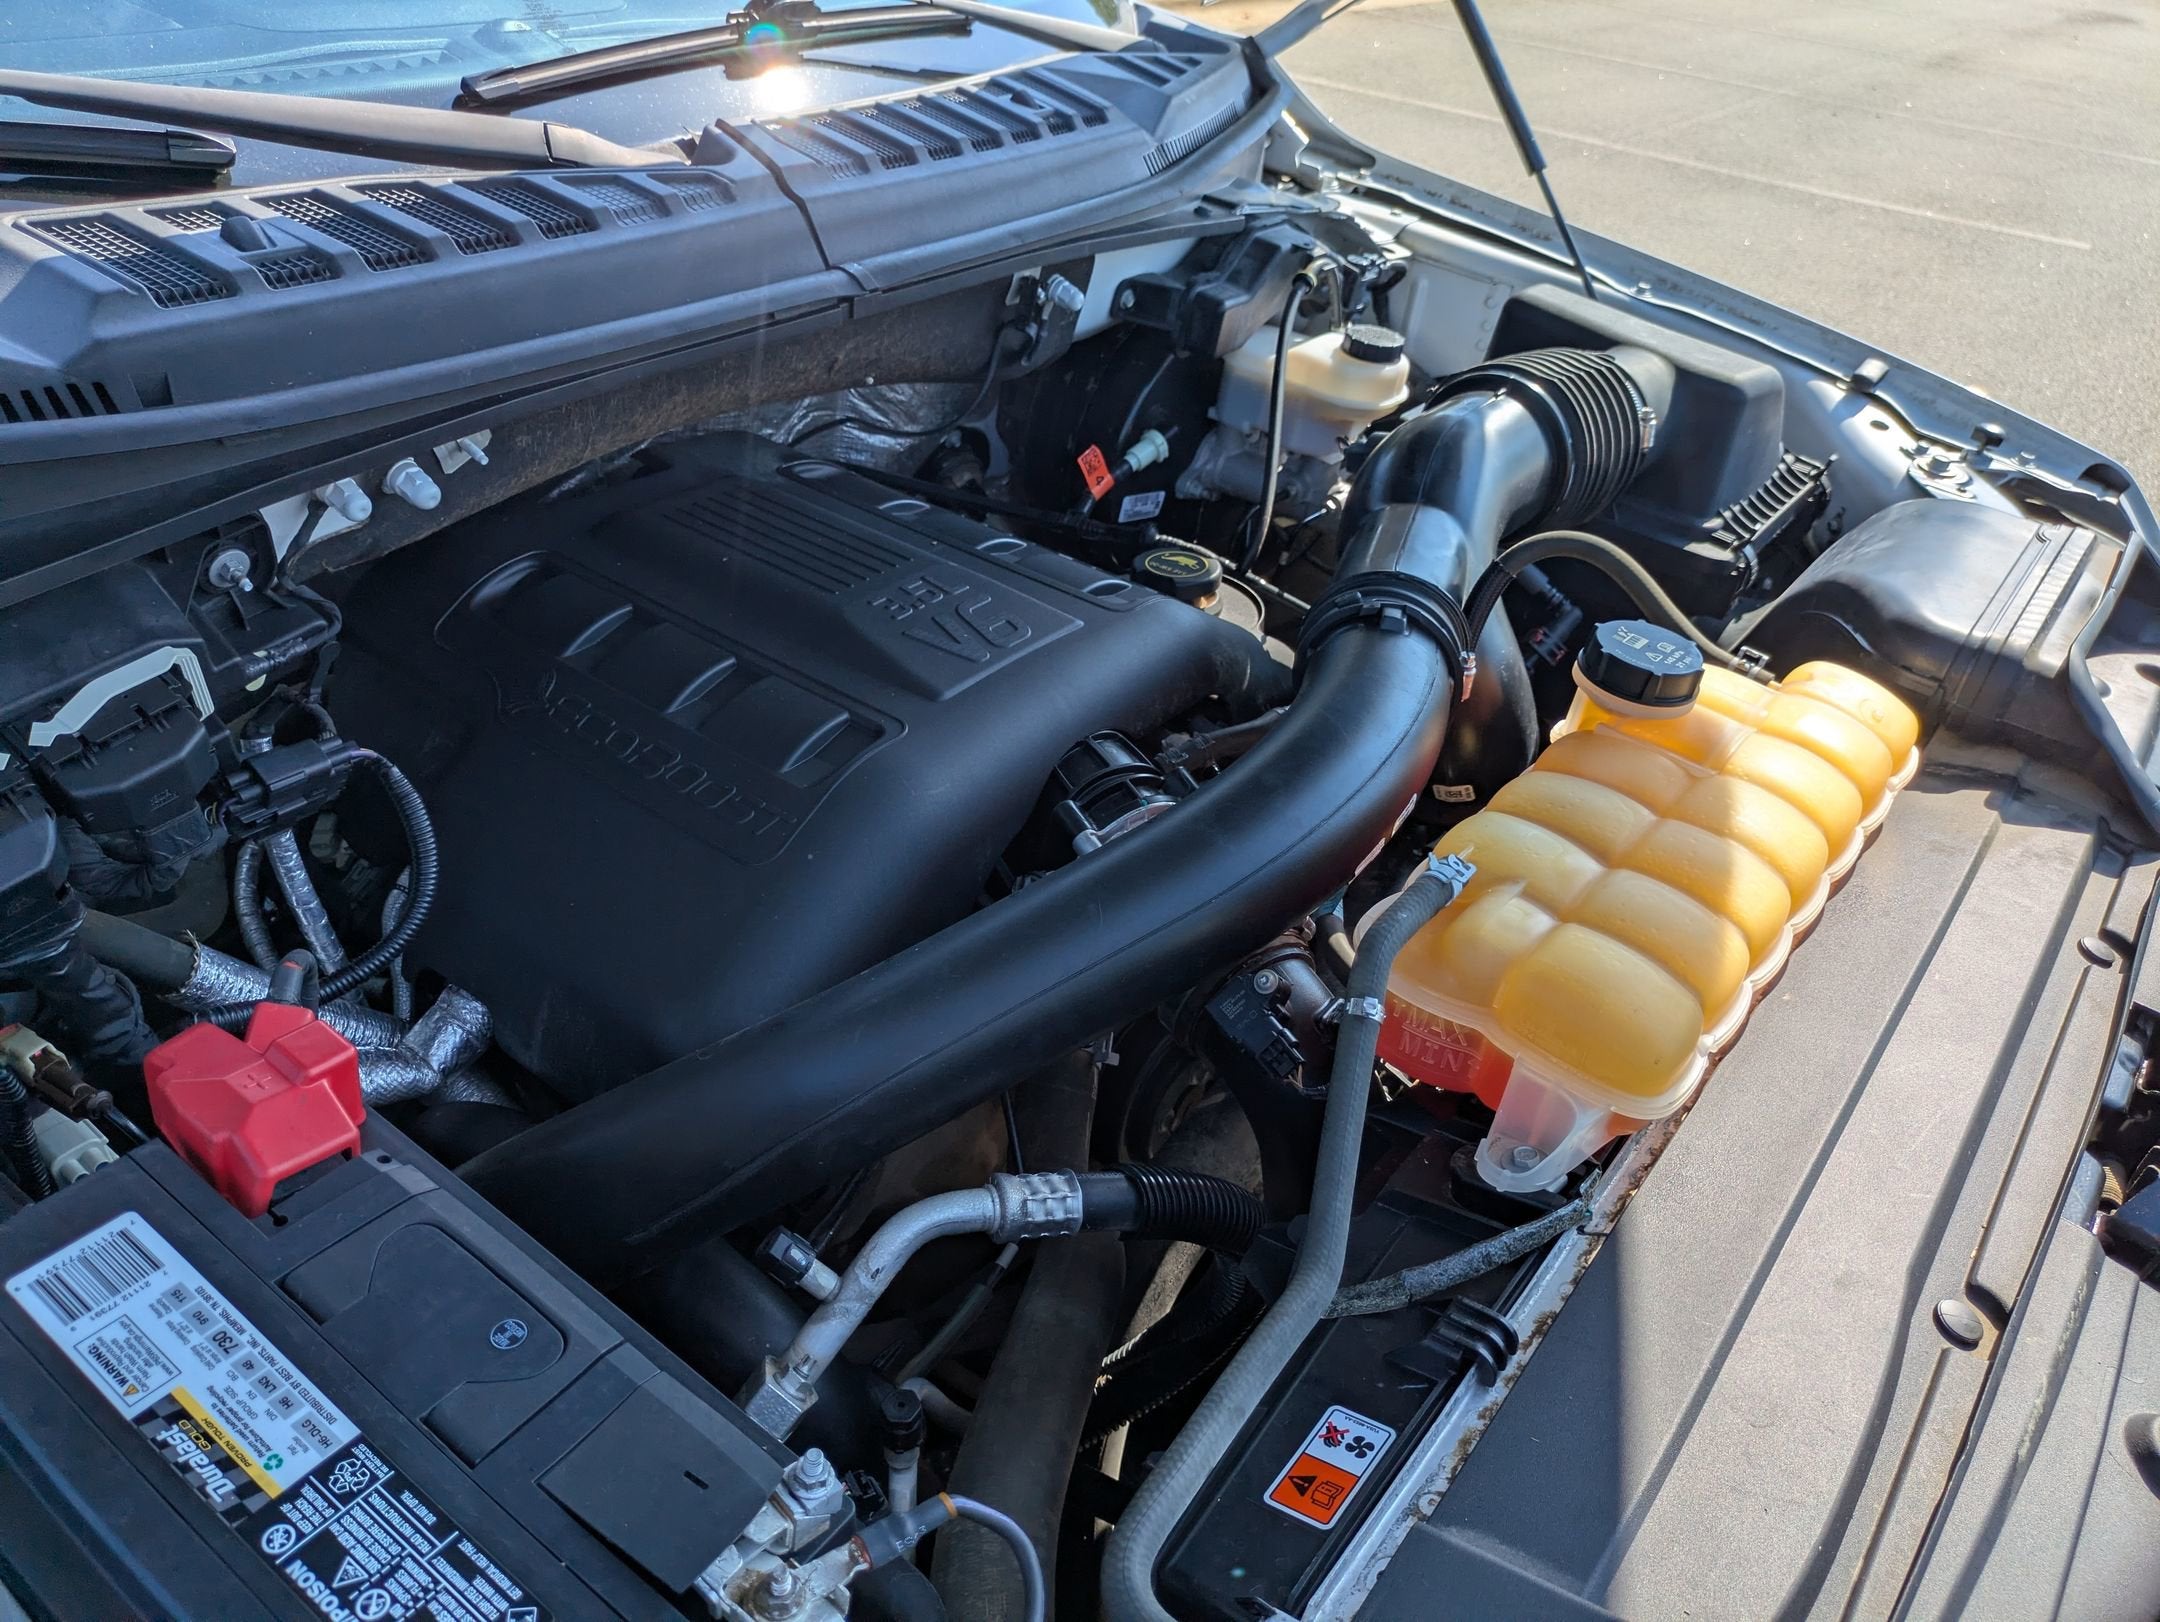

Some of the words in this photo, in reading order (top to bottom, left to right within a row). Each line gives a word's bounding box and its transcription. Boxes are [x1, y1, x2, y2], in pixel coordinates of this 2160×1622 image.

[901, 595, 1032, 664] V6
[1405, 1006, 1468, 1047] MAX
[1399, 1030, 1464, 1073] MIN
[169, 1287, 189, 1304] 115
[192, 1284, 214, 1304] 38103
[208, 1300, 222, 1311] TN
[190, 1308, 210, 1326] 910
[209, 1328, 240, 1355] 730
[83, 1342, 131, 1388] WARNING:
[240, 1358, 256, 1372] 48
[254, 1345, 280, 1368] PARTS,
[224, 1368, 239, 1382] BCI
[273, 1364, 294, 1382] BEST
[222, 1384, 239, 1400] SIZE
[256, 1374, 278, 1393] LN3
[287, 1378, 302, 1390] BY
[204, 1383, 231, 1408] recycling
[244, 1388, 258, 1400] EN
[277, 1395, 294, 1410] H6
[224, 1404, 246, 1423] proper
[235, 1397, 260, 1420] GROUP
[262, 1407, 278, 1421] DIN
[296, 1386, 337, 1425] DISTRIBUTED
[200, 1416, 226, 1441] TOUGH
[213, 1407, 239, 1431] batteries
[238, 1420, 251, 1431] for
[176, 1416, 213, 1453] GOLD
[234, 1427, 250, 1442] used
[246, 1427, 273, 1453] AutoZone
[299, 1417, 333, 1449] H6-DLG
[222, 1438, 253, 1468] PROVEN
[245, 1438, 266, 1459] Return
[349, 1445, 366, 1460] MUST
[356, 1442, 383, 1467] RECYCLED
[153, 1421, 238, 1504] Duralast
[361, 1456, 386, 1479] BATTERY
[378, 1463, 390, 1473] BE
[340, 1470, 355, 1482] Pb
[278, 1500, 294, 1513] OF
[292, 1496, 317, 1517] REACH
[396, 1488, 420, 1508] OPEN.
[284, 1507, 303, 1523] OUT
[307, 1510, 326, 1526] THE
[320, 1504, 336, 1518] OF
[346, 1503, 375, 1528] BURNS.
[364, 1489, 416, 1538] INSTRUCTIONS.
[411, 1502, 430, 1518] NOT
[421, 1512, 438, 1526] DO
[294, 1516, 315, 1534] KEEP
[327, 1520, 345, 1536] CAN
[338, 1513, 375, 1547] BLINDNESS
[366, 1522, 395, 1548] SEVERE
[335, 1530, 358, 1549] ACID
[385, 1541, 403, 1555] OR
[407, 1531, 433, 1554] READ
[455, 1537, 478, 1557] FAST.
[348, 1543, 383, 1574] SULFURIC
[366, 1540, 393, 1564] CAUSE
[469, 1550, 491, 1569] HELP
[399, 1555, 433, 1586] SMOKING
[430, 1554, 471, 1591] IMMEDIATELY
[482, 1562, 514, 1590] MEDICAL
[381, 1576, 412, 1604] SPARKS
[392, 1567, 423, 1595] FLAMES
[468, 1573, 497, 1598] WATER.
[461, 1585, 484, 1604] EYES
[487, 1592, 512, 1612] WITH
[504, 1584, 524, 1600] GET
[386, 1601, 407, 1619] NO
[450, 1604, 467, 1618] OR
[474, 1597, 501, 1620] FLUSH
